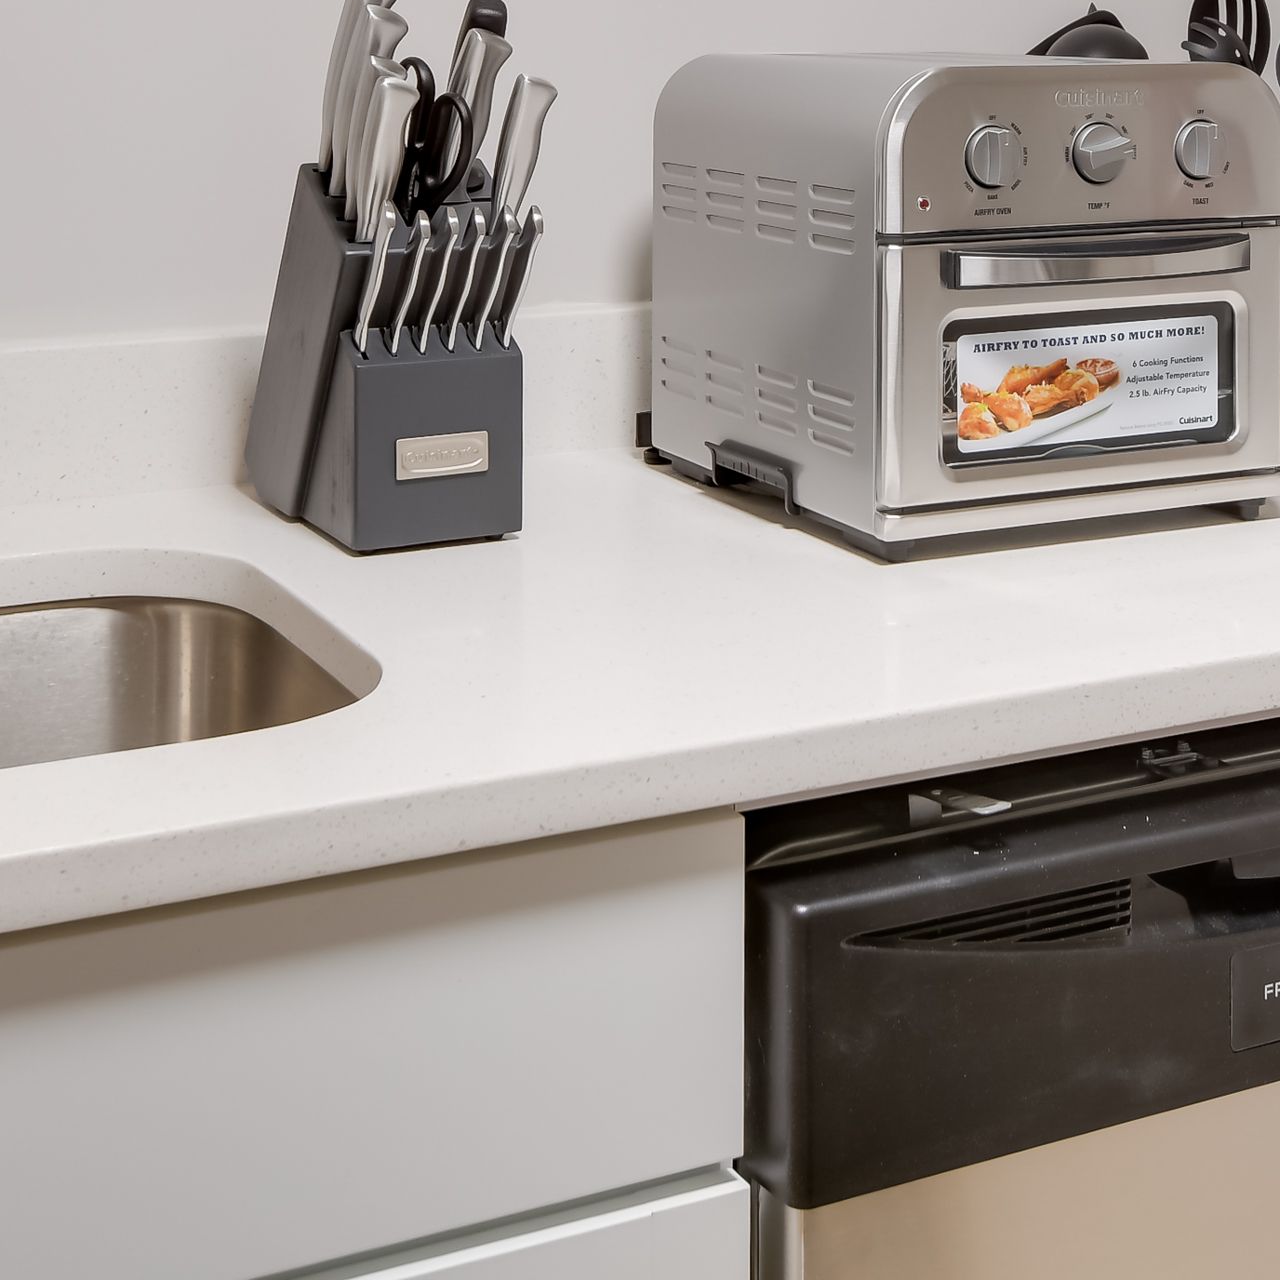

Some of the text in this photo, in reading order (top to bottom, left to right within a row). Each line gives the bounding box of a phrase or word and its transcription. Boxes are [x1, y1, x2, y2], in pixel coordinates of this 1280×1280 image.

[996, 207, 1011, 215] OVEN
[973, 326, 1205, 353] AIRFRY TO TOAST AND SO MUCH MORE!
[1132, 355, 1203, 368] 6 Cooking Functions
[1126, 370, 1210, 384] Adjustable Temperature
[1129, 384, 1207, 398] 2.5 lb. AirFry Capacity
[1179, 415, 1213, 425] Cuisinart
